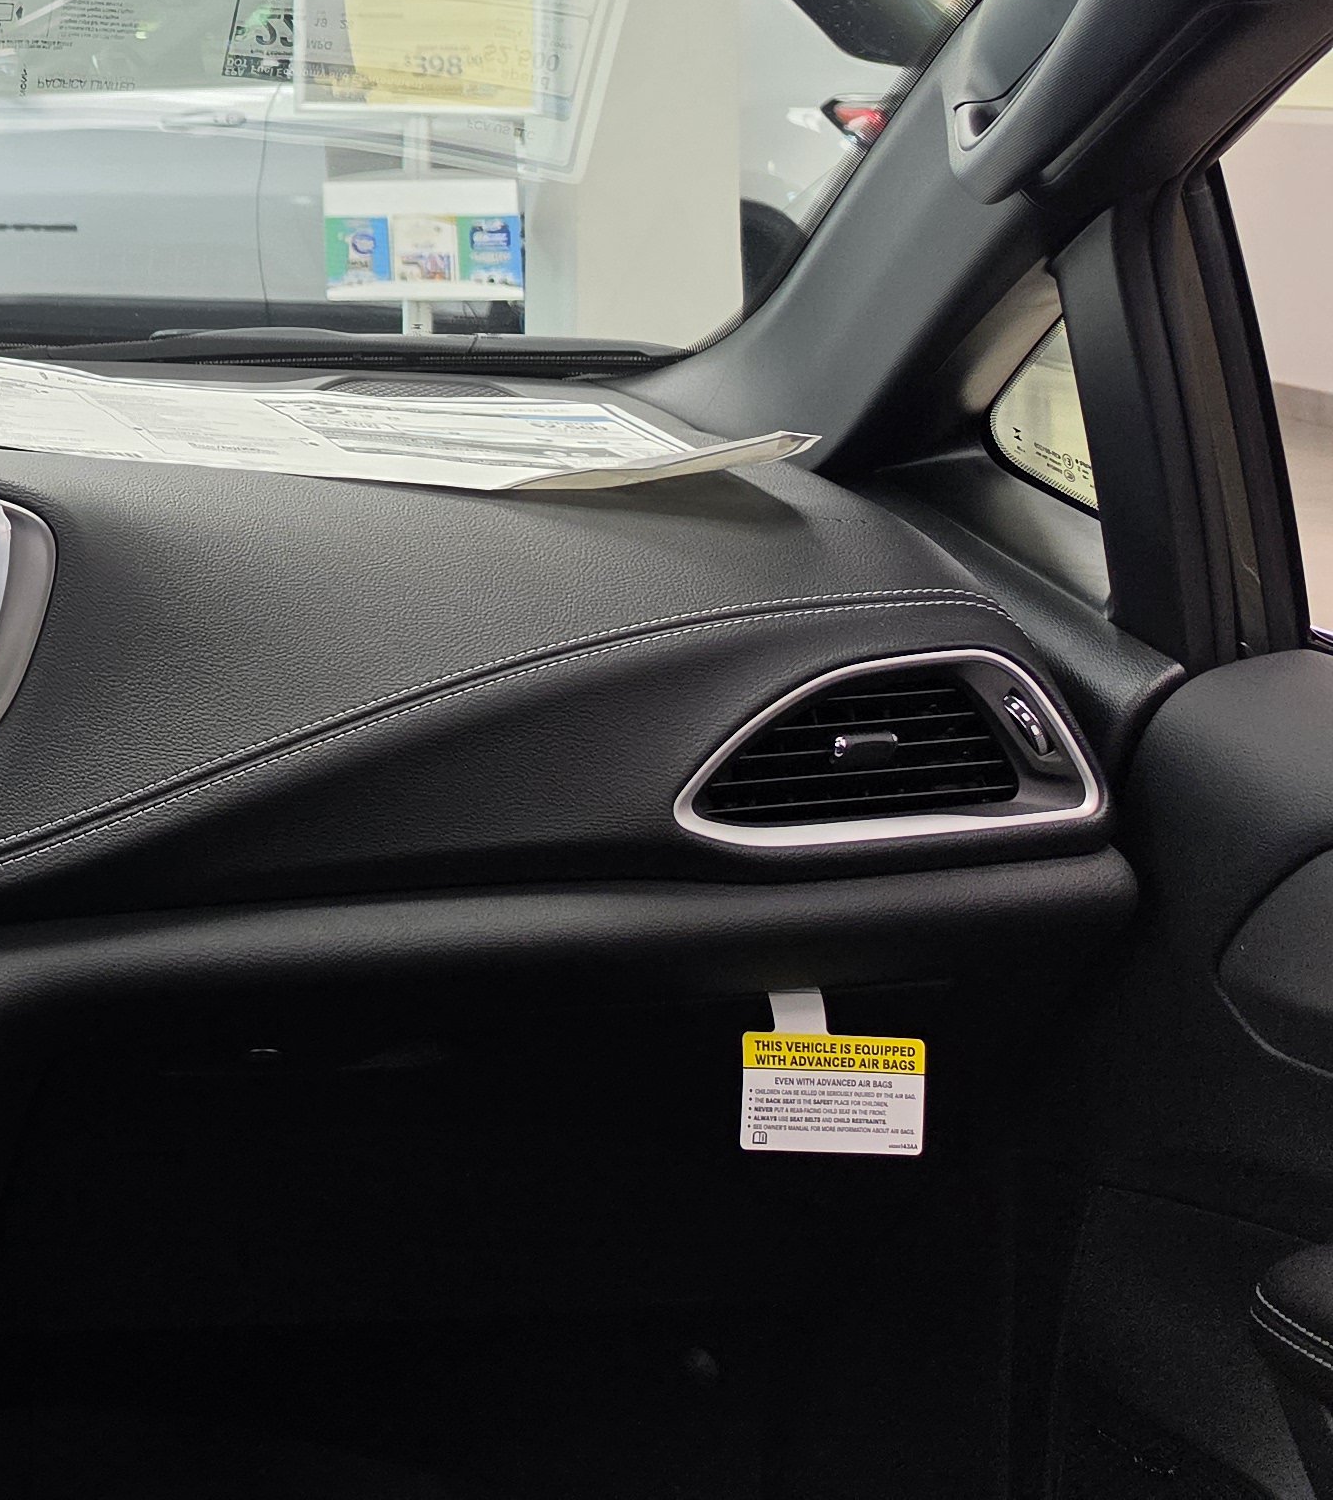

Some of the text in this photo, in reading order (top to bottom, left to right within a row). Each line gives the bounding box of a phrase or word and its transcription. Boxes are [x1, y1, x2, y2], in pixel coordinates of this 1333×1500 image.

[754, 1039, 916, 1058] THIS VEHICLE IS EQUIPPED
[754, 1054, 916, 1071] WITH ADVANCED AIR BAGS
[774, 1076, 893, 1089] EVEN WITH ADVANCED AIR BAGS
